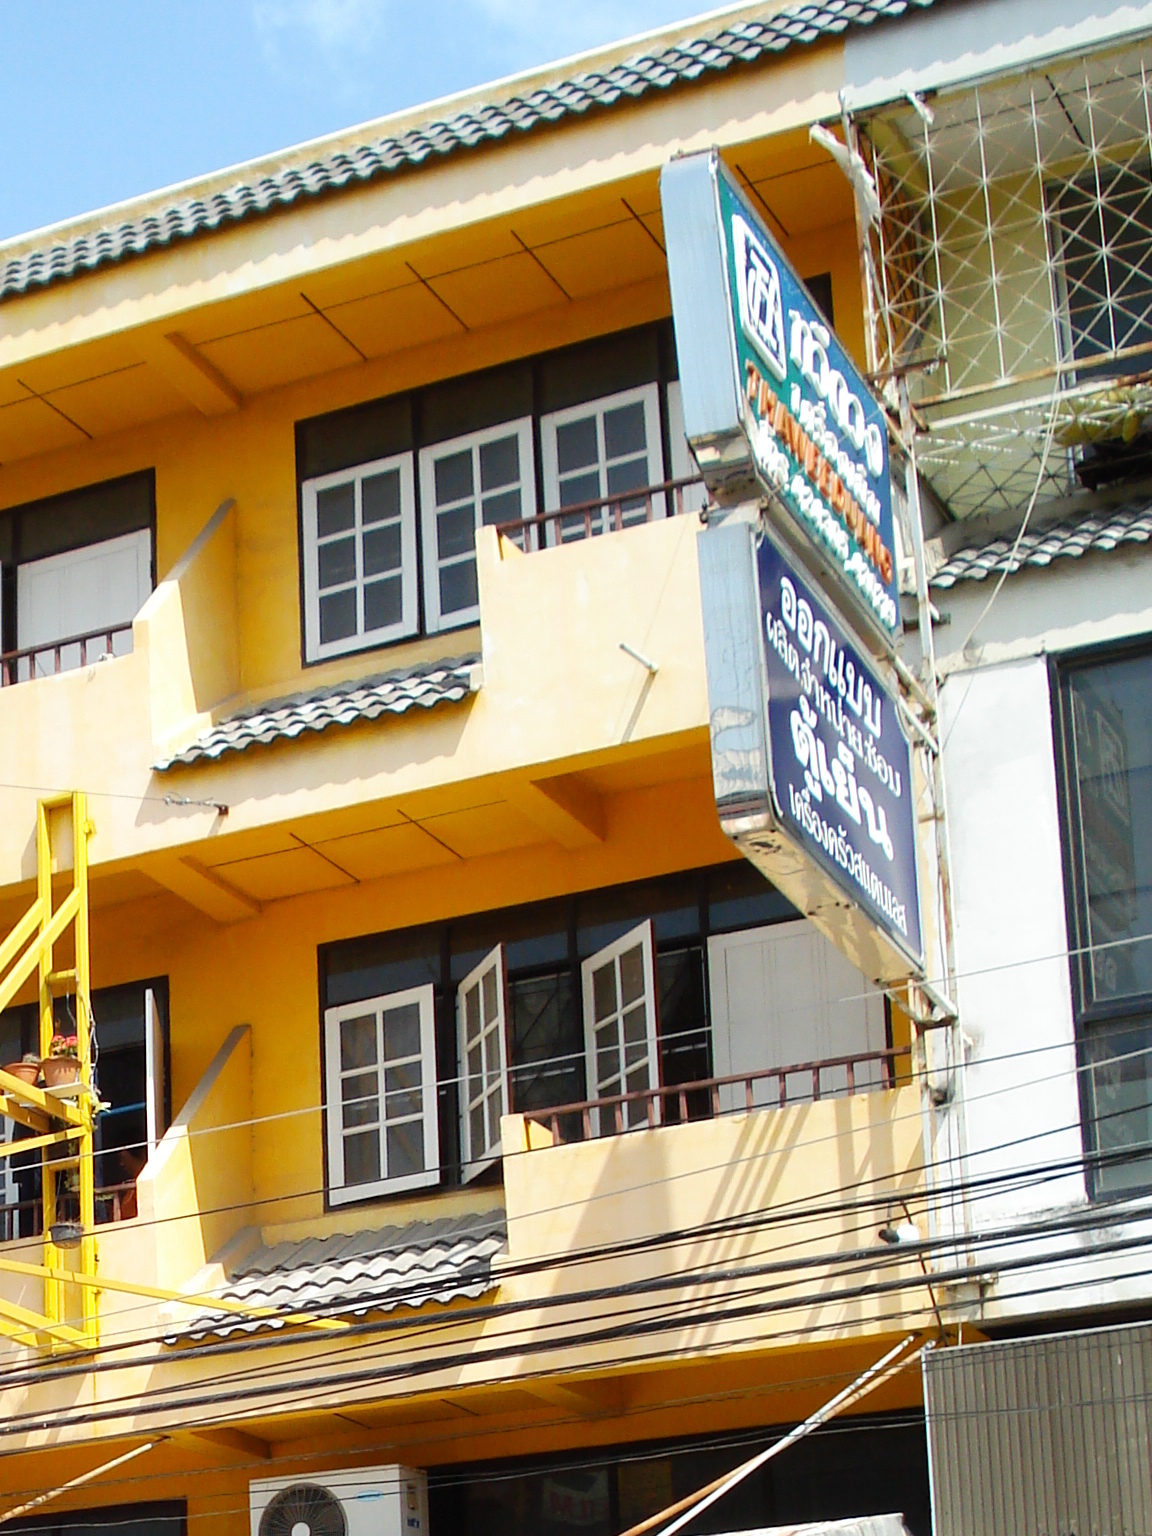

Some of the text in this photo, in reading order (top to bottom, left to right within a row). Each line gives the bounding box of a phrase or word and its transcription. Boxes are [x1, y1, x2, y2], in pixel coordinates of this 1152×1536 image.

[781, 577, 883, 739] ออกแบบ
[791, 695, 894, 860] ตู้เย็น
